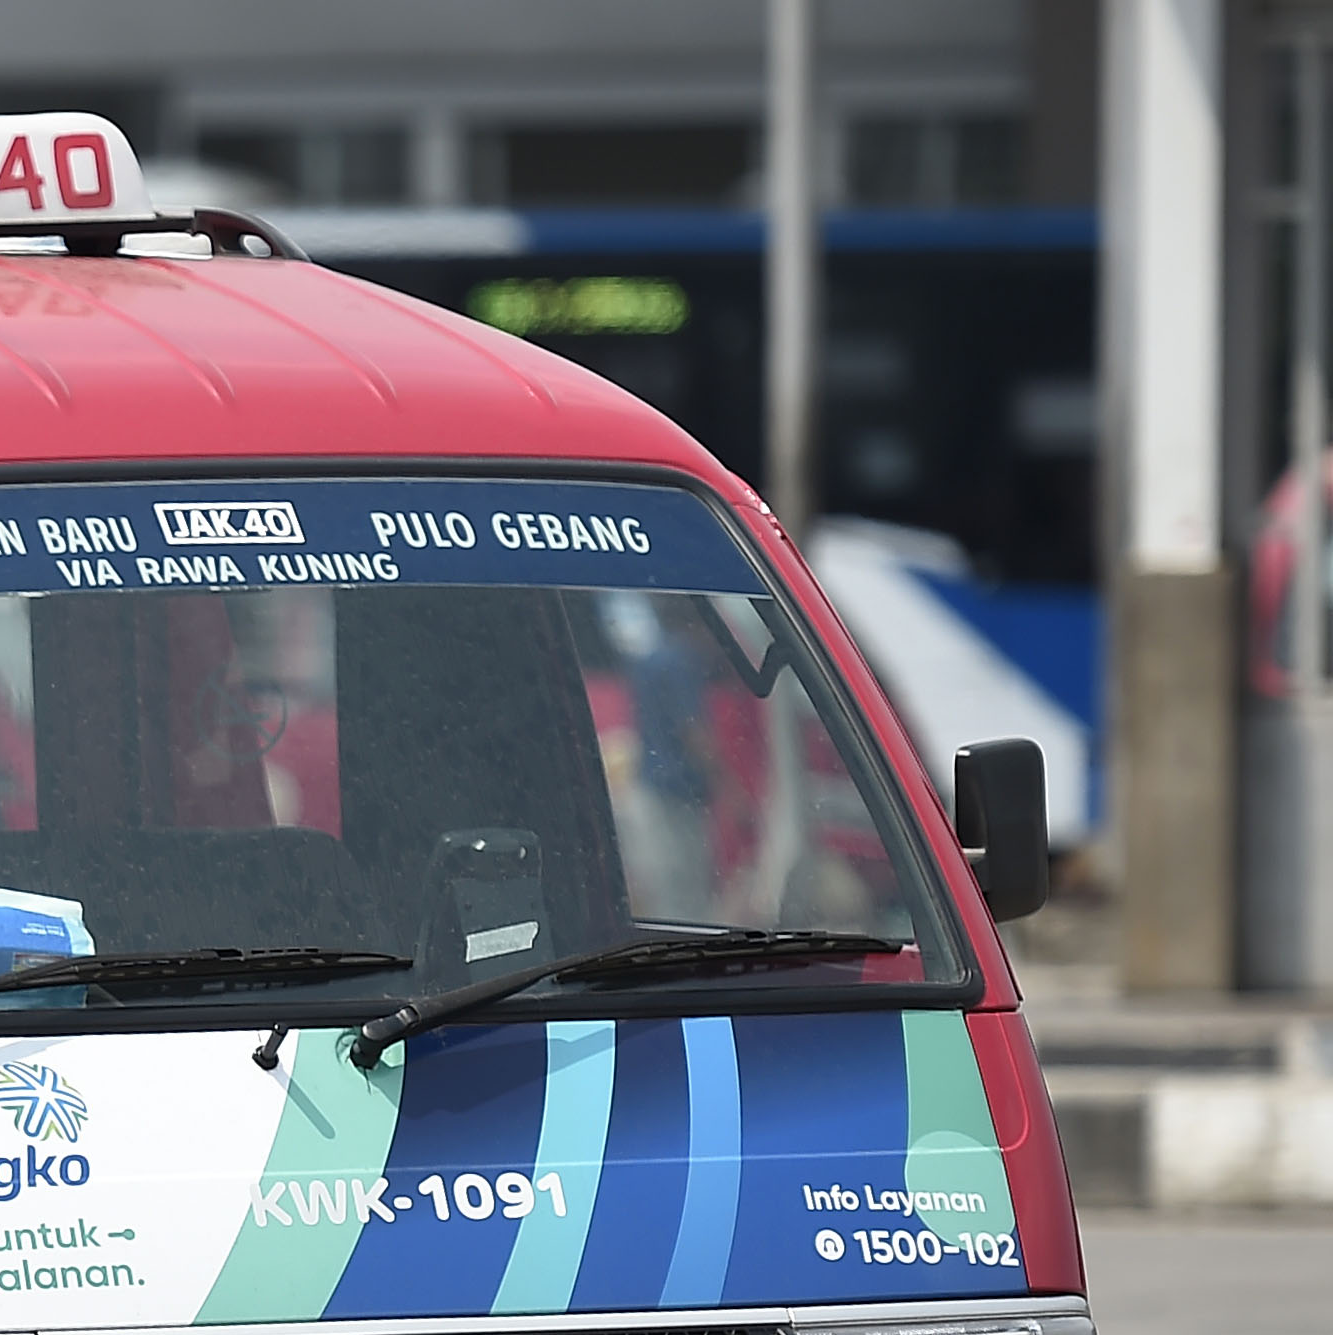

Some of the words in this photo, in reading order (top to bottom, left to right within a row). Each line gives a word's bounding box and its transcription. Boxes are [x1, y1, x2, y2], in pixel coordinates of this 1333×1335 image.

[37, 515, 138, 555] BARU
[170, 507, 294, 540] JAK.40
[370, 511, 477, 549] PULO
[491, 511, 651, 554] GEBANG
[56, 558, 123, 588] VIA
[136, 555, 246, 585] RAWA
[257, 553, 400, 582] KUNING
[248, 1170, 569, 1228] KWK-1091
[802, 1184, 860, 1211] Info
[863, 1184, 987, 1217] Layanan
[853, 1229, 1021, 1267] 1500-102
